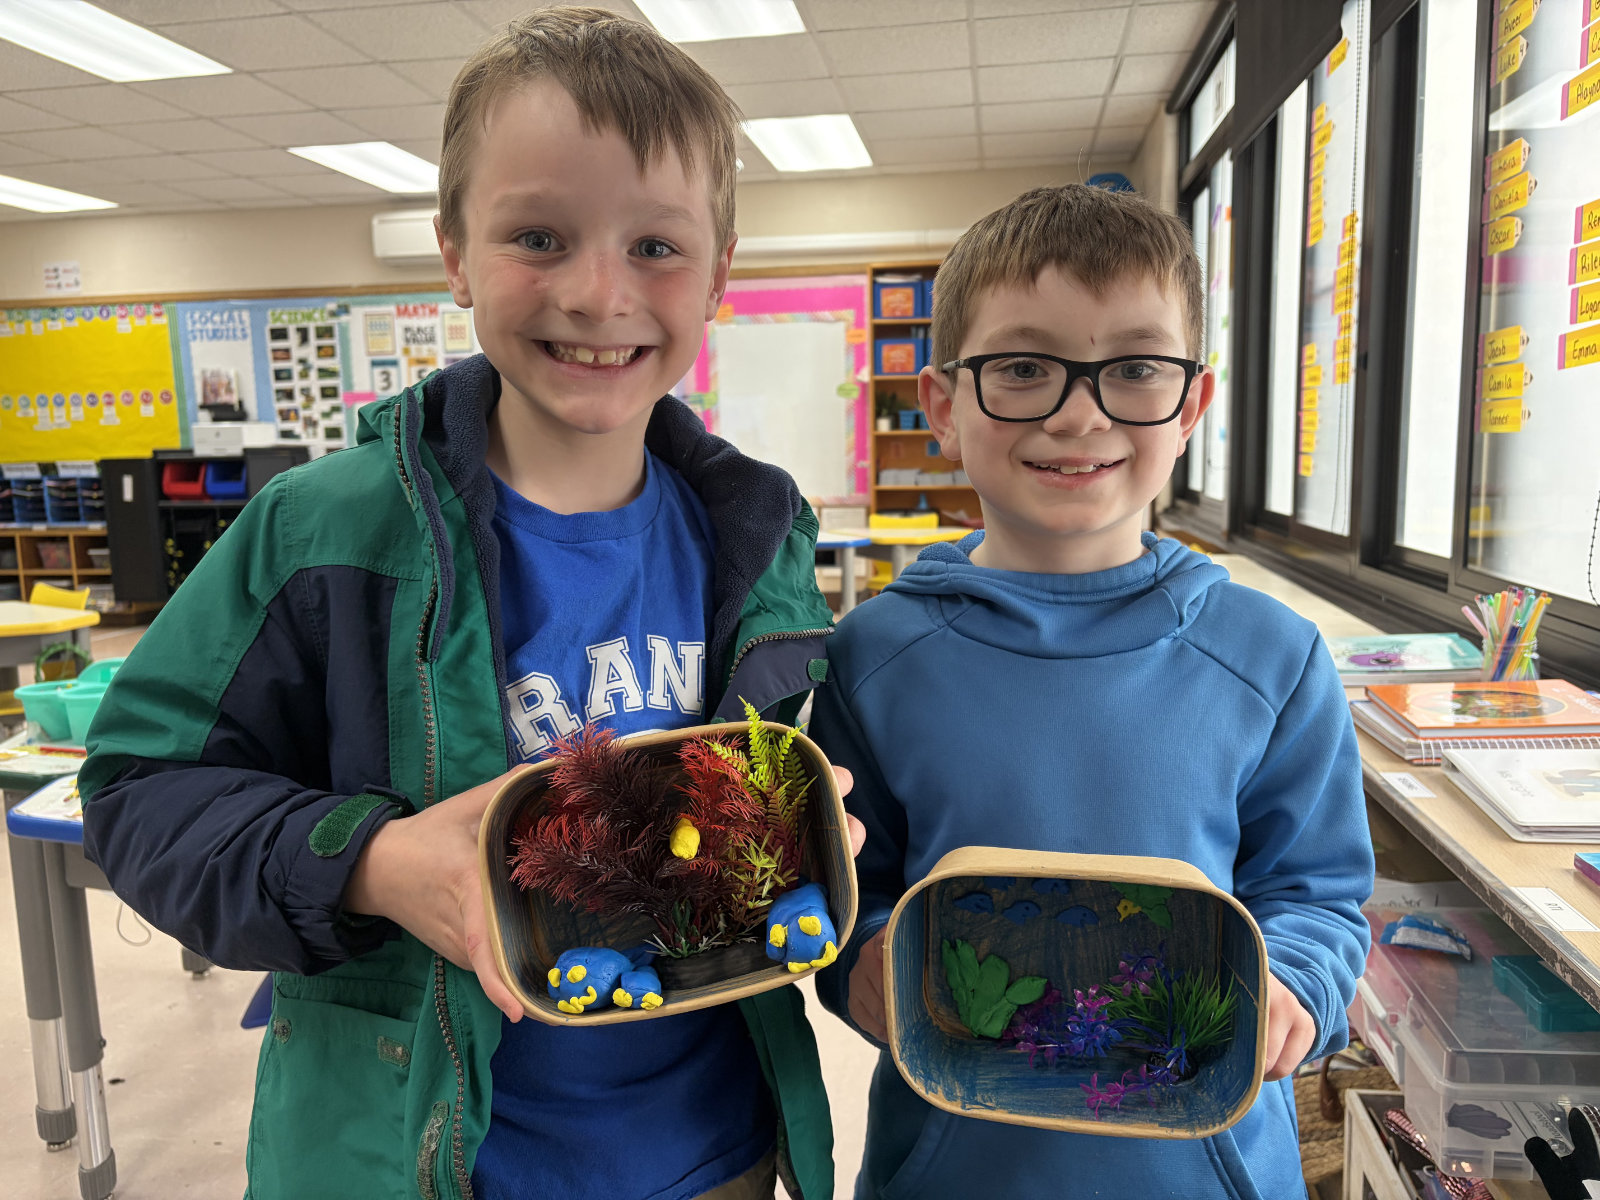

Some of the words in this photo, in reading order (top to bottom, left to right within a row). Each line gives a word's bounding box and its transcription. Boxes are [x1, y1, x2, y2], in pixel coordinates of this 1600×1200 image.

[188, 310, 247, 326] SOCIAL
[269, 308, 327, 324] SCIENCE
[396, 304, 439, 318] MATH
[188, 327, 249, 342] STUDIES
[1572, 339, 1598, 360] Emma
[379, 370, 392, 391] 3
[1488, 373, 1512, 391] Camila
[1488, 408, 1510, 425] Tanner
